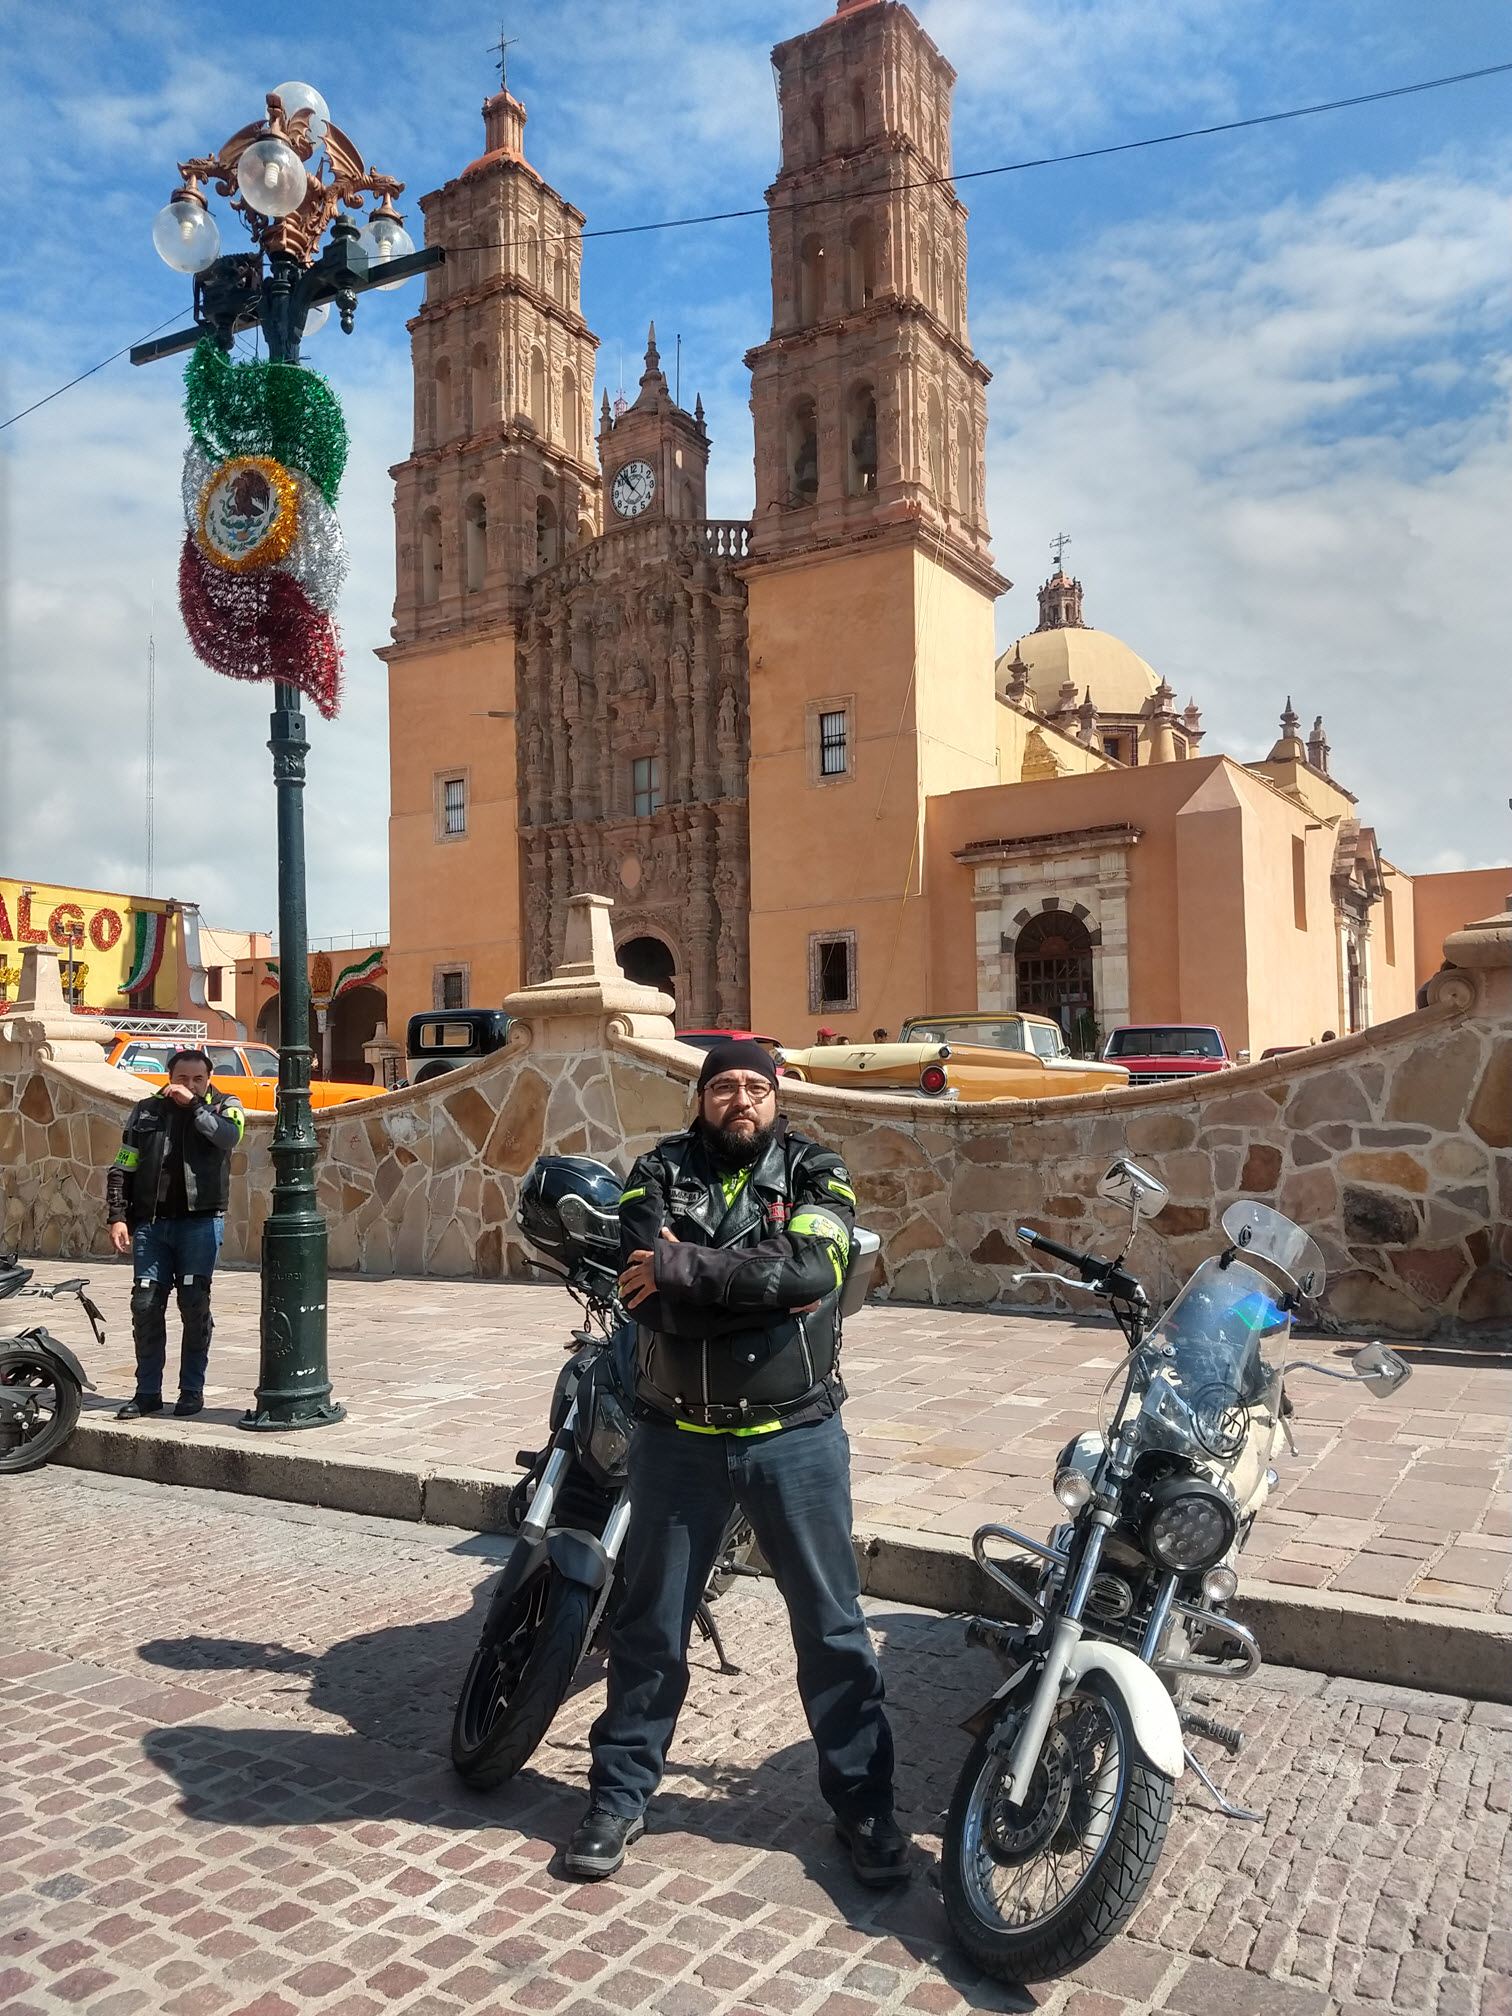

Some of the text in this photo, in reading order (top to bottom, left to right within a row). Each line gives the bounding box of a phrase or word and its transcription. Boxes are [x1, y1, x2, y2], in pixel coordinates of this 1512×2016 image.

[630, 464, 638, 474] 12
[646, 470, 651, 479] 2
[649, 480, 654, 488] 3
[614, 490, 619, 498] 9
[645, 491, 651, 500] 4
[617, 500, 622, 508] 8
[640, 501, 645, 509] 5
[632, 505, 637, 514] 6
